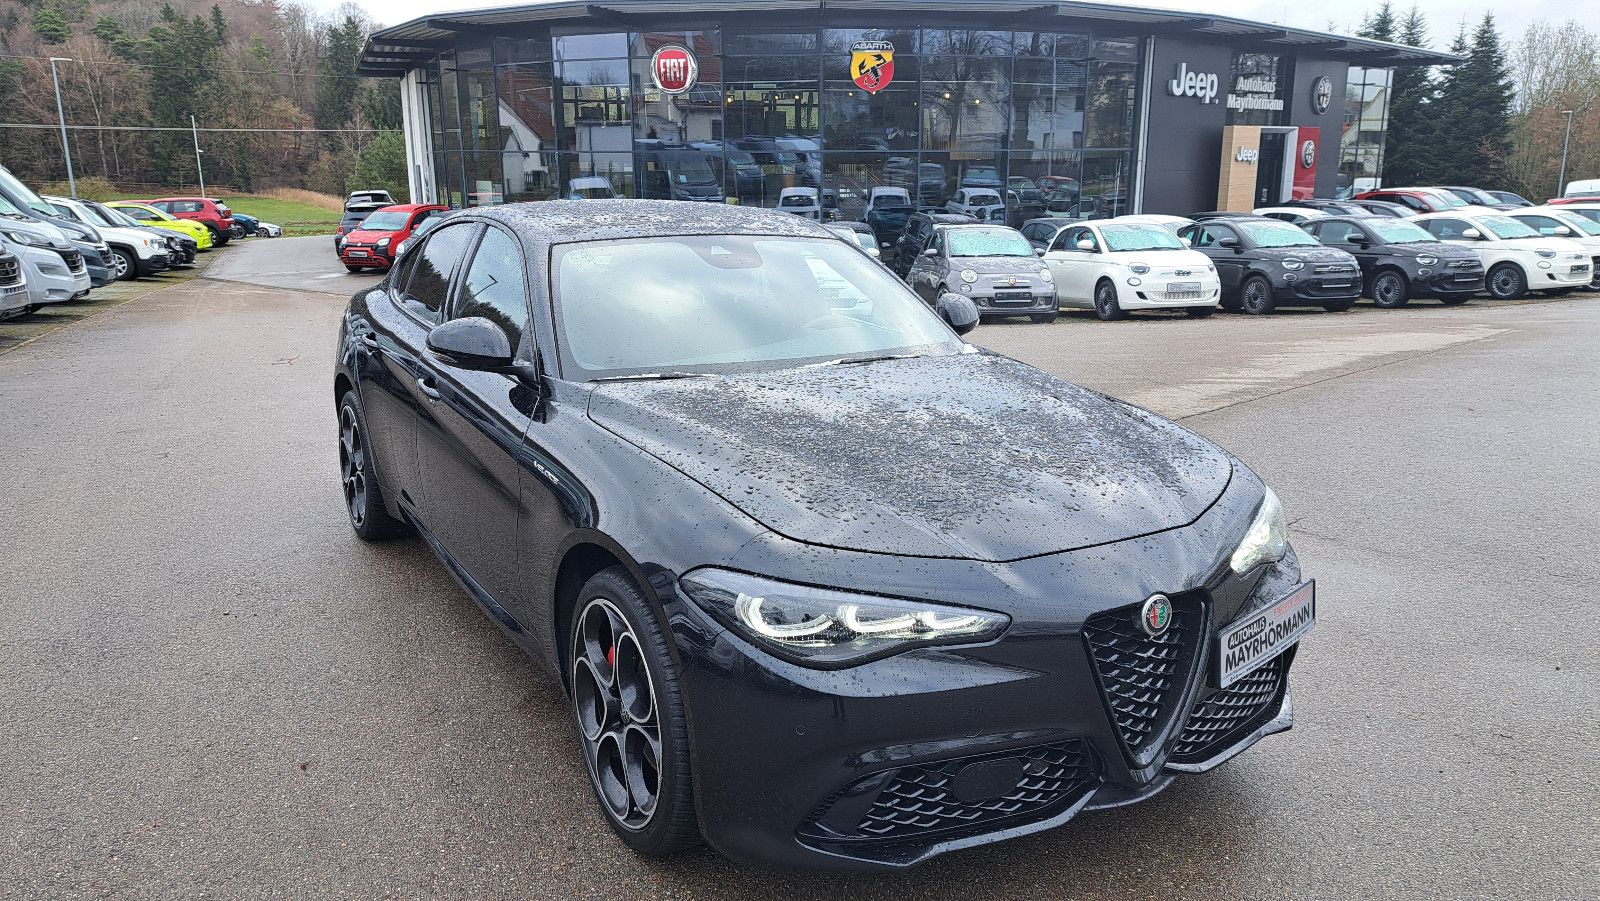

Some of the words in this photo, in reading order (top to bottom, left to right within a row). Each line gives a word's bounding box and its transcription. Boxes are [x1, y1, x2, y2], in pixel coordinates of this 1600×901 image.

[659, 58, 686, 81] FIAT
[1171, 62, 1218, 104] Jeep
[1236, 76, 1276, 93] Autohaus
[1236, 144, 1258, 165] Jeep
[1225, 602, 1310, 674] MAYRHÖRMANN
[1229, 617, 1266, 649] AUTOHAUS
